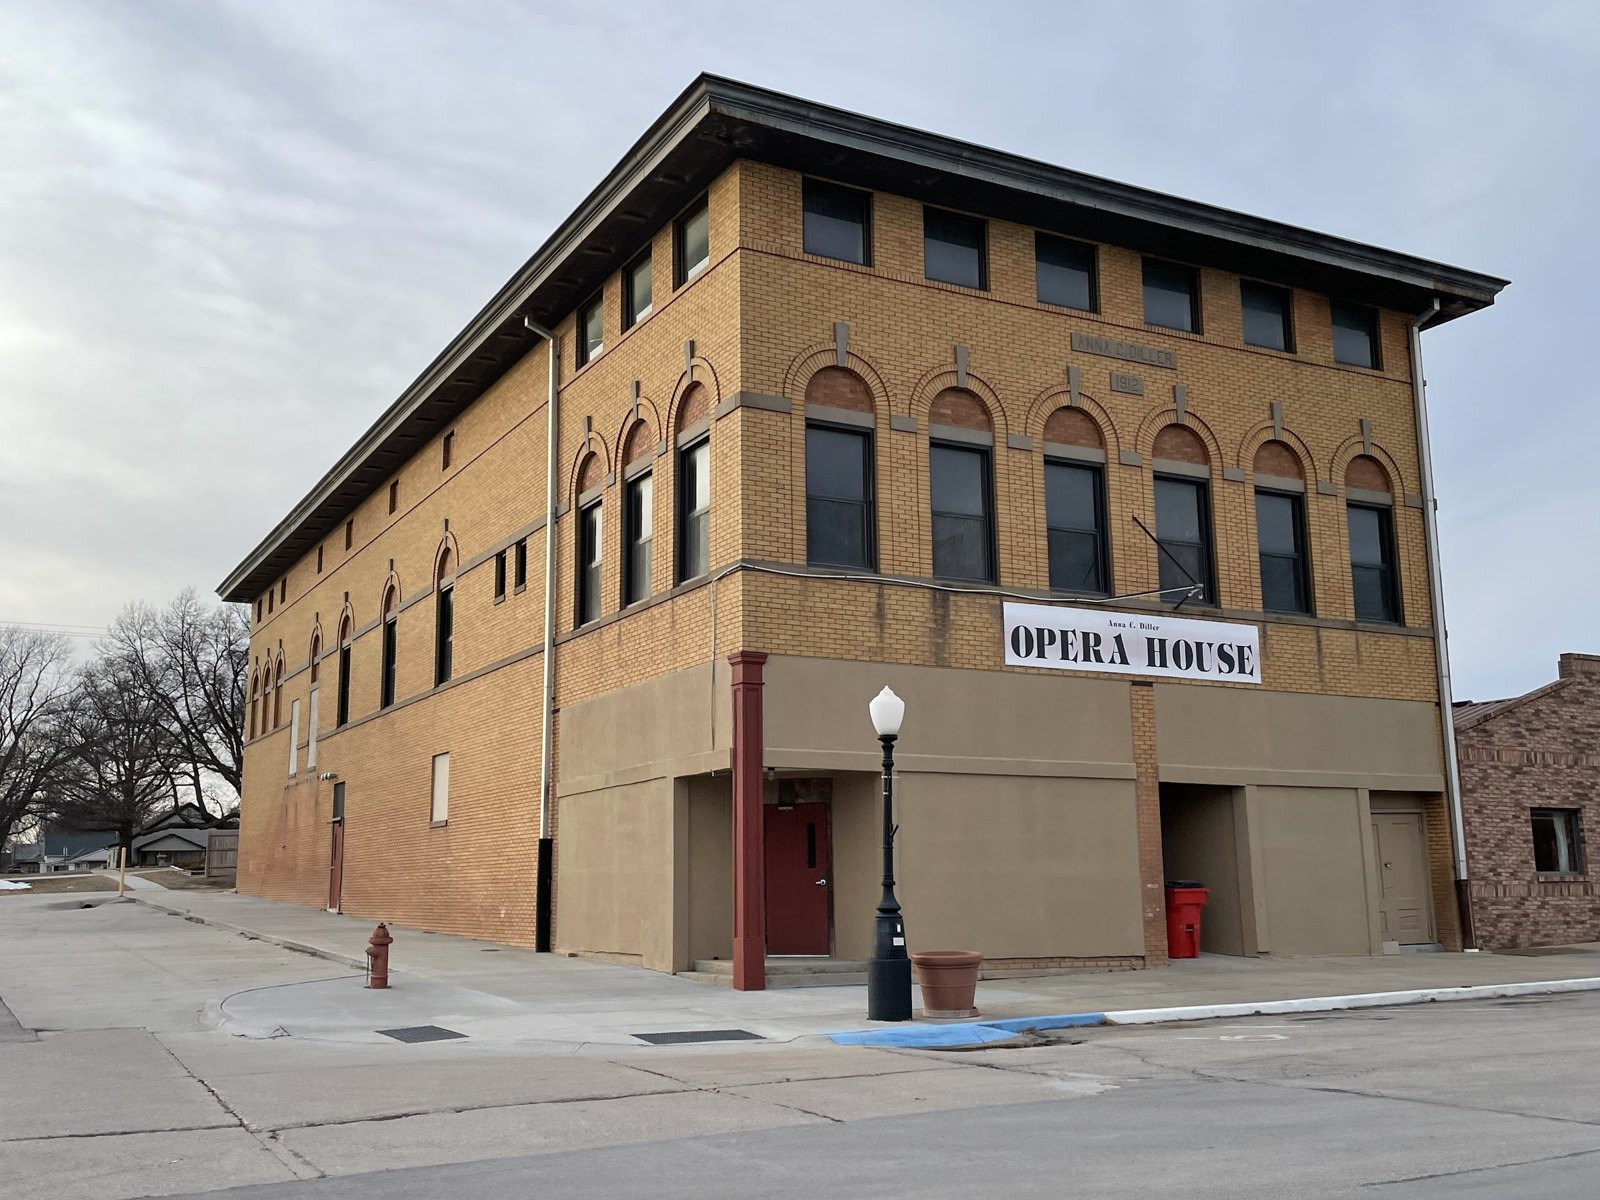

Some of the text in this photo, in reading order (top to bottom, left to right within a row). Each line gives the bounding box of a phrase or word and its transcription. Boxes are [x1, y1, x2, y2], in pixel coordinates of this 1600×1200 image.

[1078, 336, 1110, 355] ANNA
[1129, 345, 1172, 365] DILLER
[1115, 375, 1139, 392] 1912
[1108, 619, 1160, 631] Anna C. Diller
[1010, 624, 1255, 677] OPERA HOUSE
